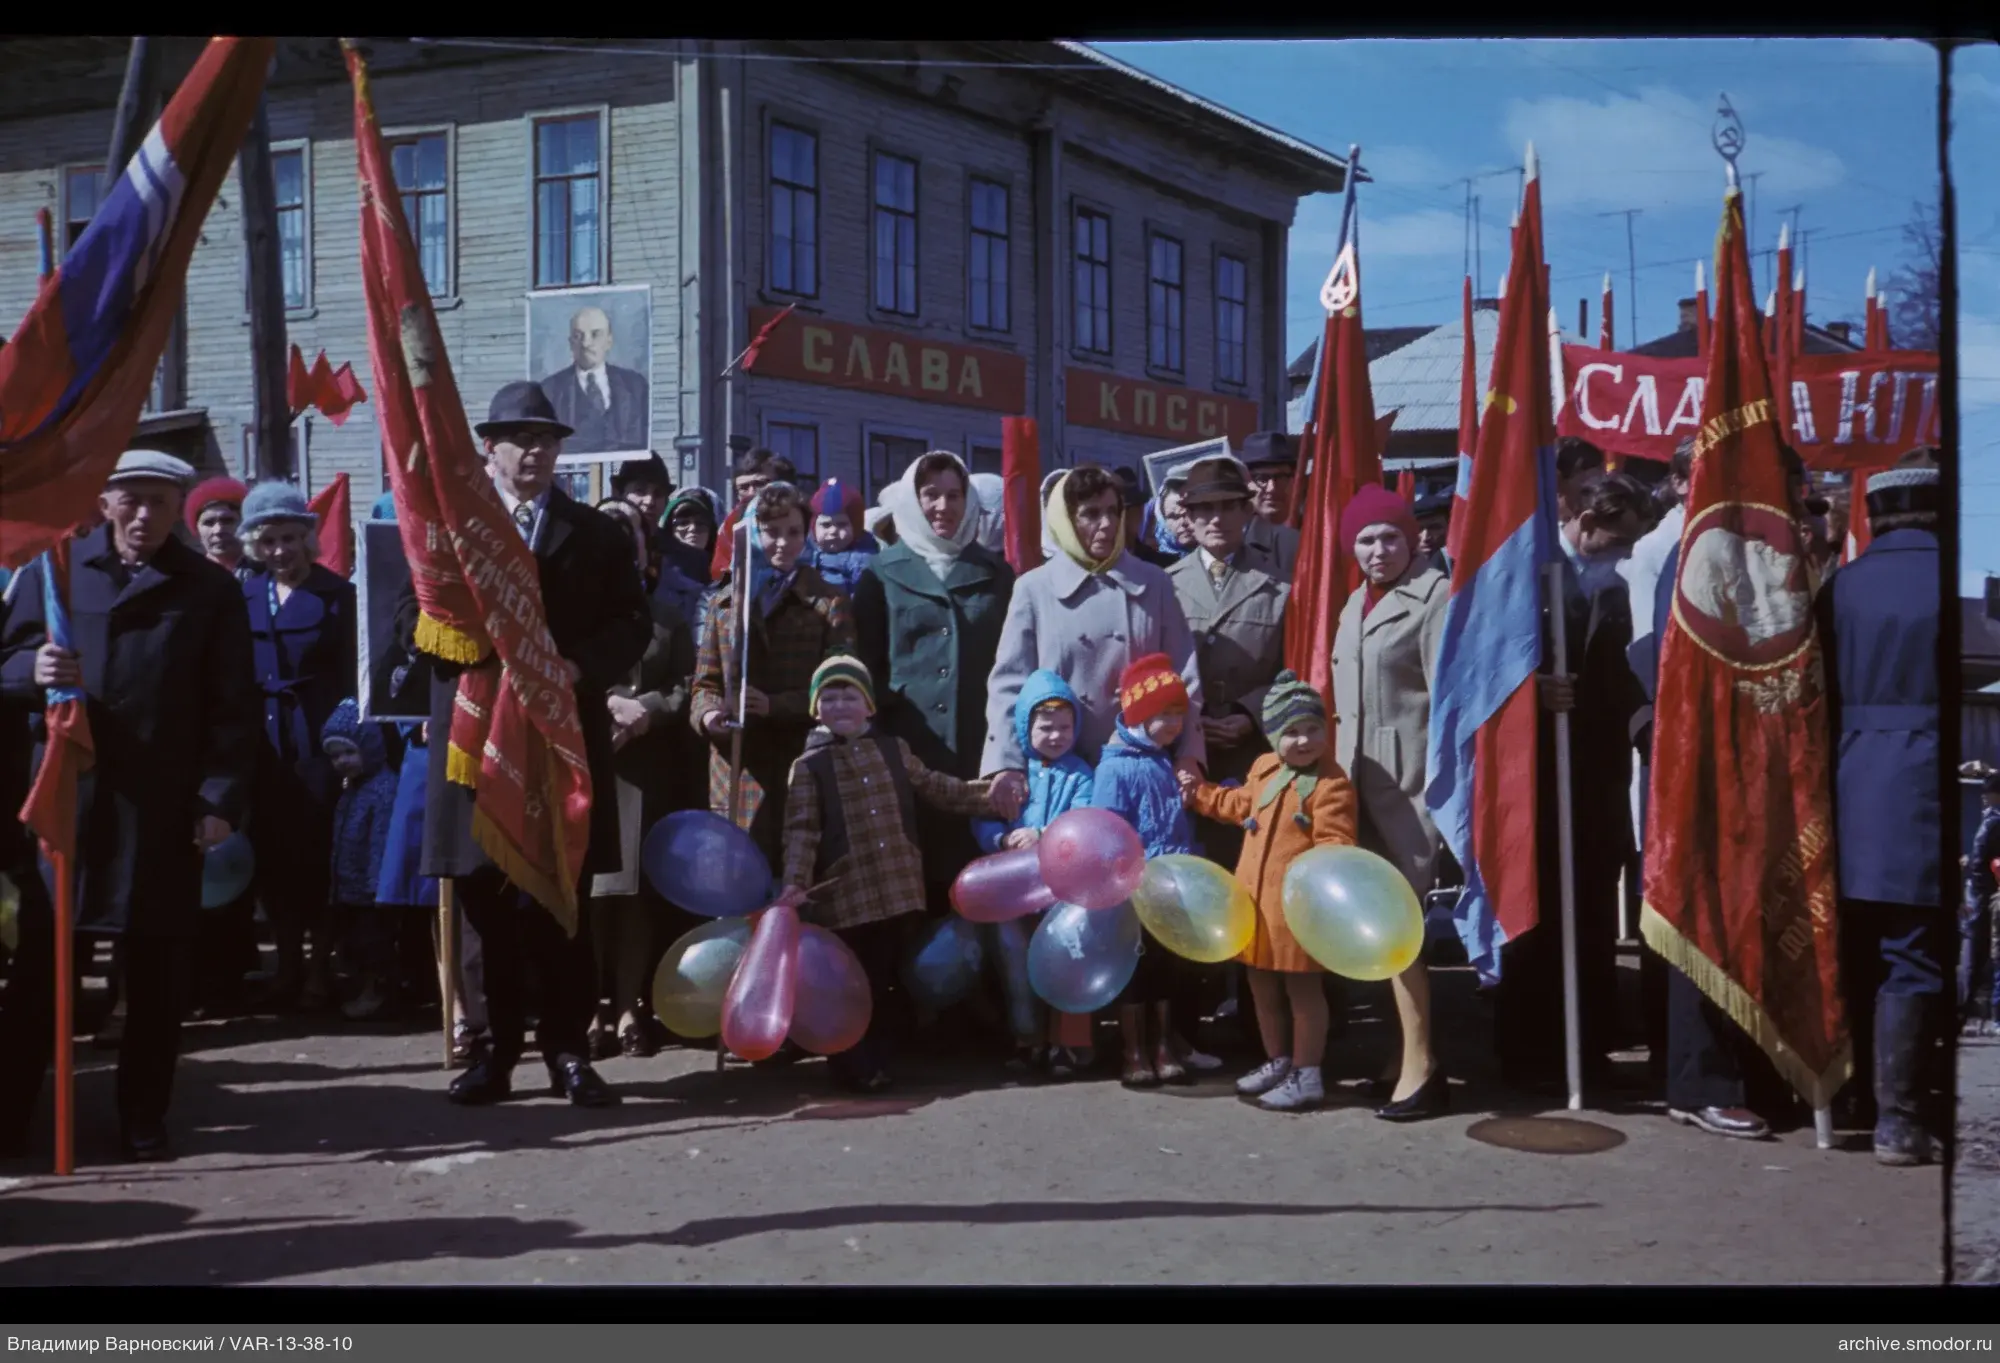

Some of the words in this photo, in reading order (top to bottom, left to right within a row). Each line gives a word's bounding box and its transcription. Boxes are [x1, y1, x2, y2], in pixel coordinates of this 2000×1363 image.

[802, 325, 983, 398] СЛАВА
[1573, 362, 1819, 444] СЛАА
[683, 453, 694, 467] 8
